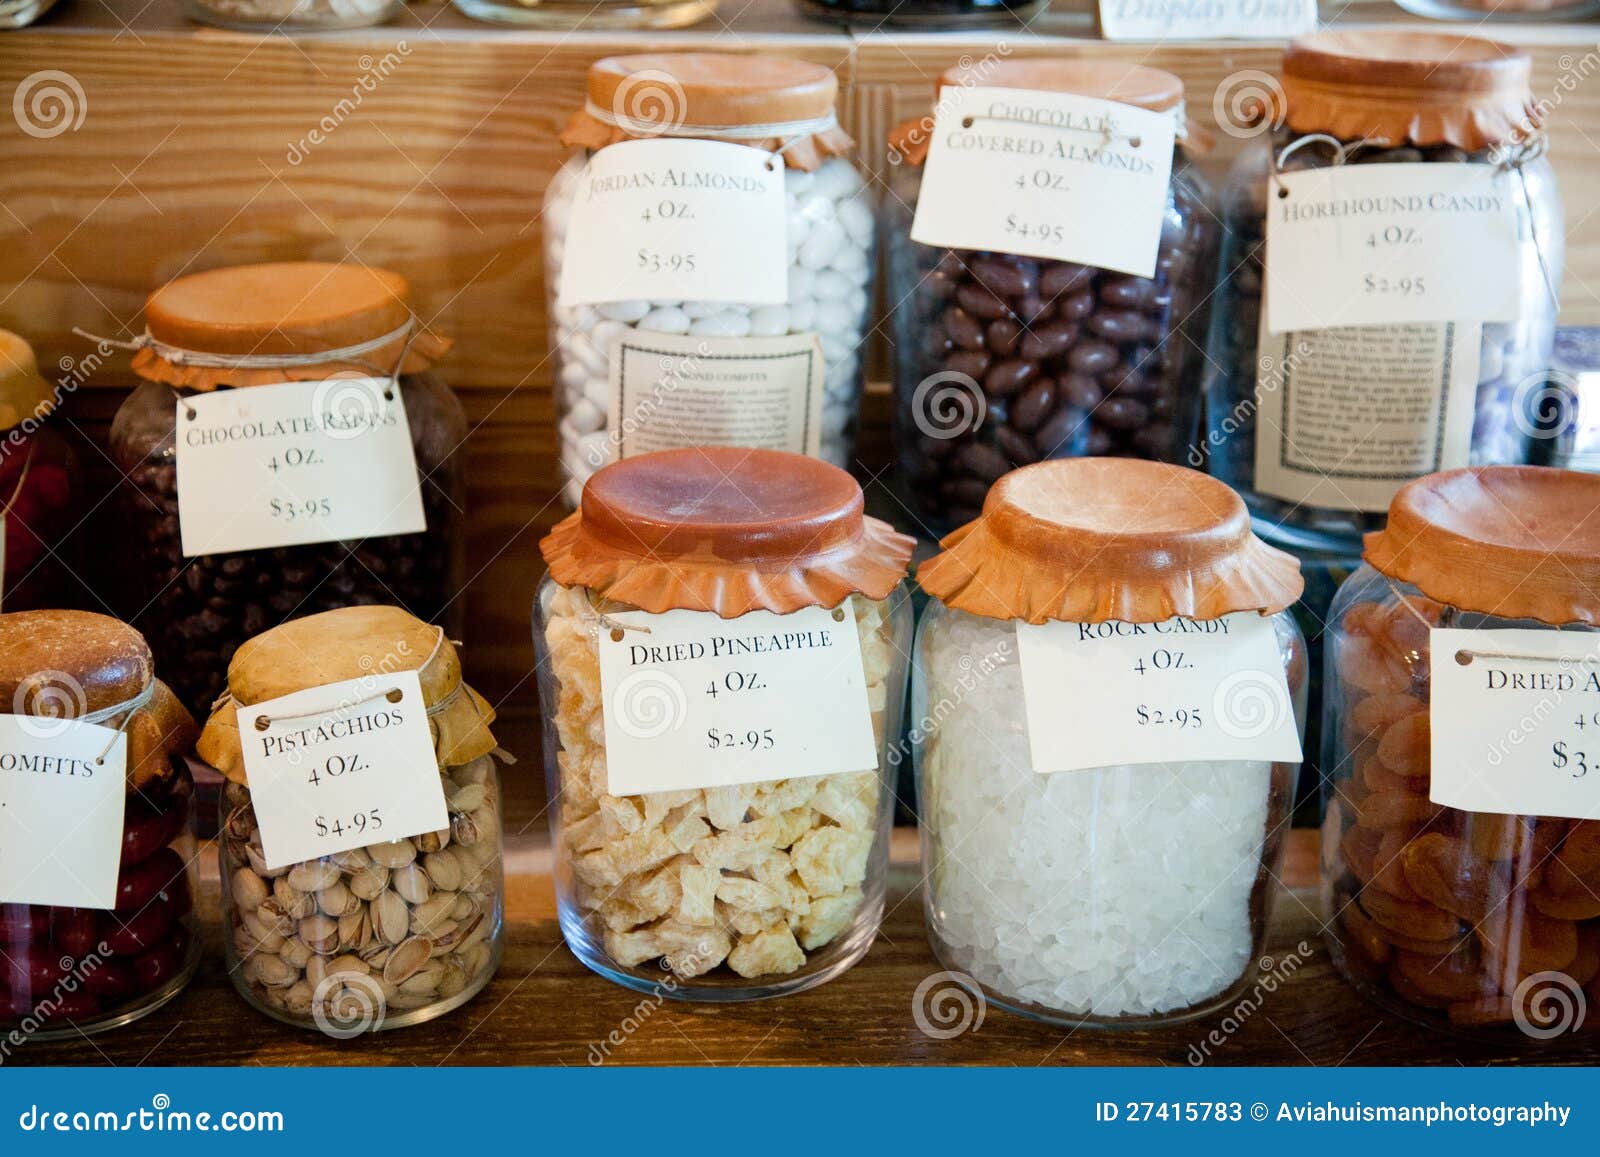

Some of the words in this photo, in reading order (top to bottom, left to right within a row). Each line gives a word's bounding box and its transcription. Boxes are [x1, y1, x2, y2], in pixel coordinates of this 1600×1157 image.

[946, 131, 1044, 156] COVERED
[1049, 140, 1153, 174] ALMONDS
[661, 169, 767, 193] ALMONDS
[1015, 175, 1025, 189] 4
[642, 208, 652, 222] 4
[1282, 197, 1423, 223] HOREHOUND
[1429, 192, 1504, 213] CANDY
[187, 417, 316, 447] CHOCOLATE
[268, 457, 278, 473] 4
[270, 499, 331, 521] $3.95
[630, 642, 705, 666] DRIED
[711, 631, 833, 657] PINEAPPLE
[1134, 658, 1146, 676] 4
[706, 681, 719, 699] 4
[1487, 670, 1574, 690] DRIED
[1136, 704, 1202, 729] $2.95
[1574, 711, 1586, 730] 4
[262, 709, 404, 758] PISTACHIOS
[708, 728, 775, 751] $2.95
[308, 769, 321, 787] 4
[315, 808, 383, 838] $4.95
